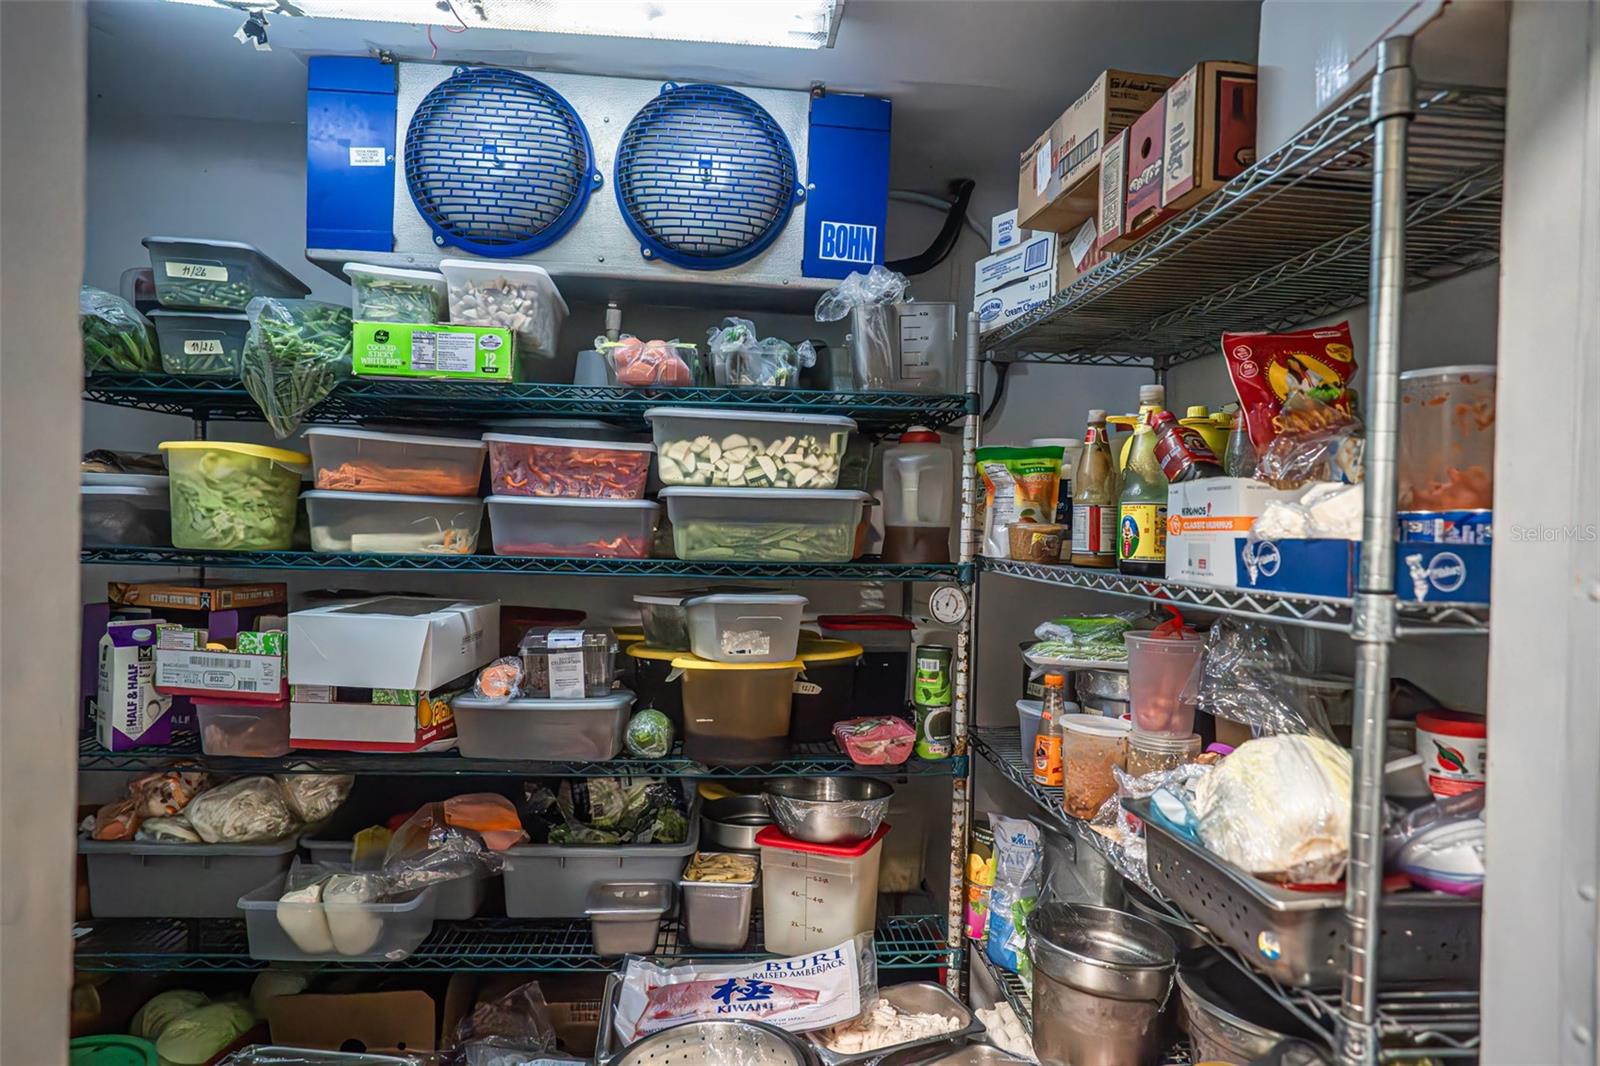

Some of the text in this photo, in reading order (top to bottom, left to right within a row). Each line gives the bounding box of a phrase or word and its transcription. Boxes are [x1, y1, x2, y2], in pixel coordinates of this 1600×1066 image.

[822, 223, 875, 262] BOHN
[182, 265, 207, 277] 11/26
[1004, 305, 1022, 318] Cream
[361, 357, 386, 365] WHITE
[484, 353, 497, 367] 12
[126, 664, 139, 727] HALF & HALF
[171, 715, 190, 725] ALF
[766, 949, 842, 971] BURI
[752, 971, 788, 980] RAISED
[789, 959, 847, 978] AMBERJACK
[711, 978, 774, 1002] 極
[717, 1003, 774, 1014] KIWAMI
